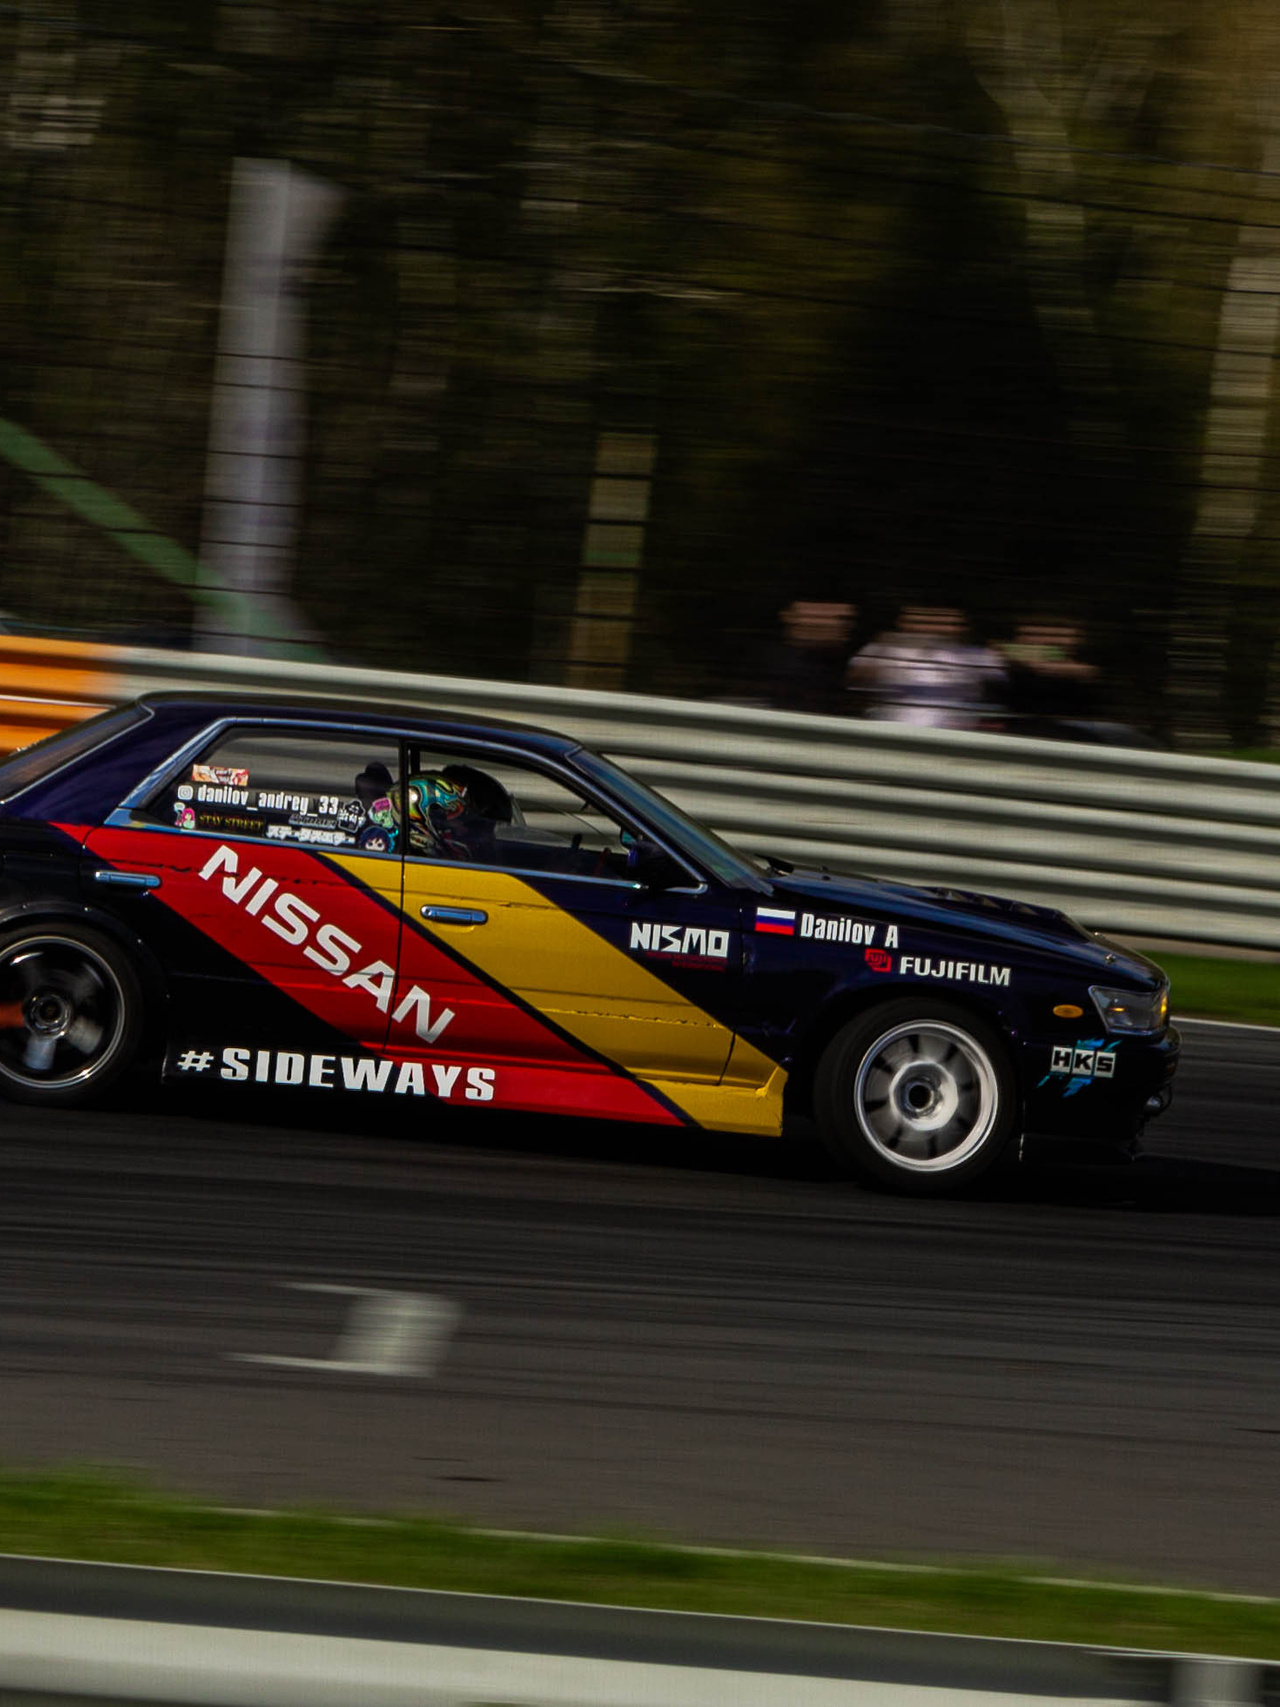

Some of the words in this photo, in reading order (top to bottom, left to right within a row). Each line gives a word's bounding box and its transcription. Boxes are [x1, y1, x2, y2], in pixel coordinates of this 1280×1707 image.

[197, 784, 339, 817] danilov_andrey_33
[198, 844, 456, 1045] NISSAN
[630, 921, 730, 958] NISMO
[800, 913, 876, 947] Danilov
[885, 924, 899, 950] A
[899, 956, 1012, 987] FUJIFILM
[177, 1047, 497, 1101] #SIDEWAYS
[1051, 1046, 1117, 1077] HKS
